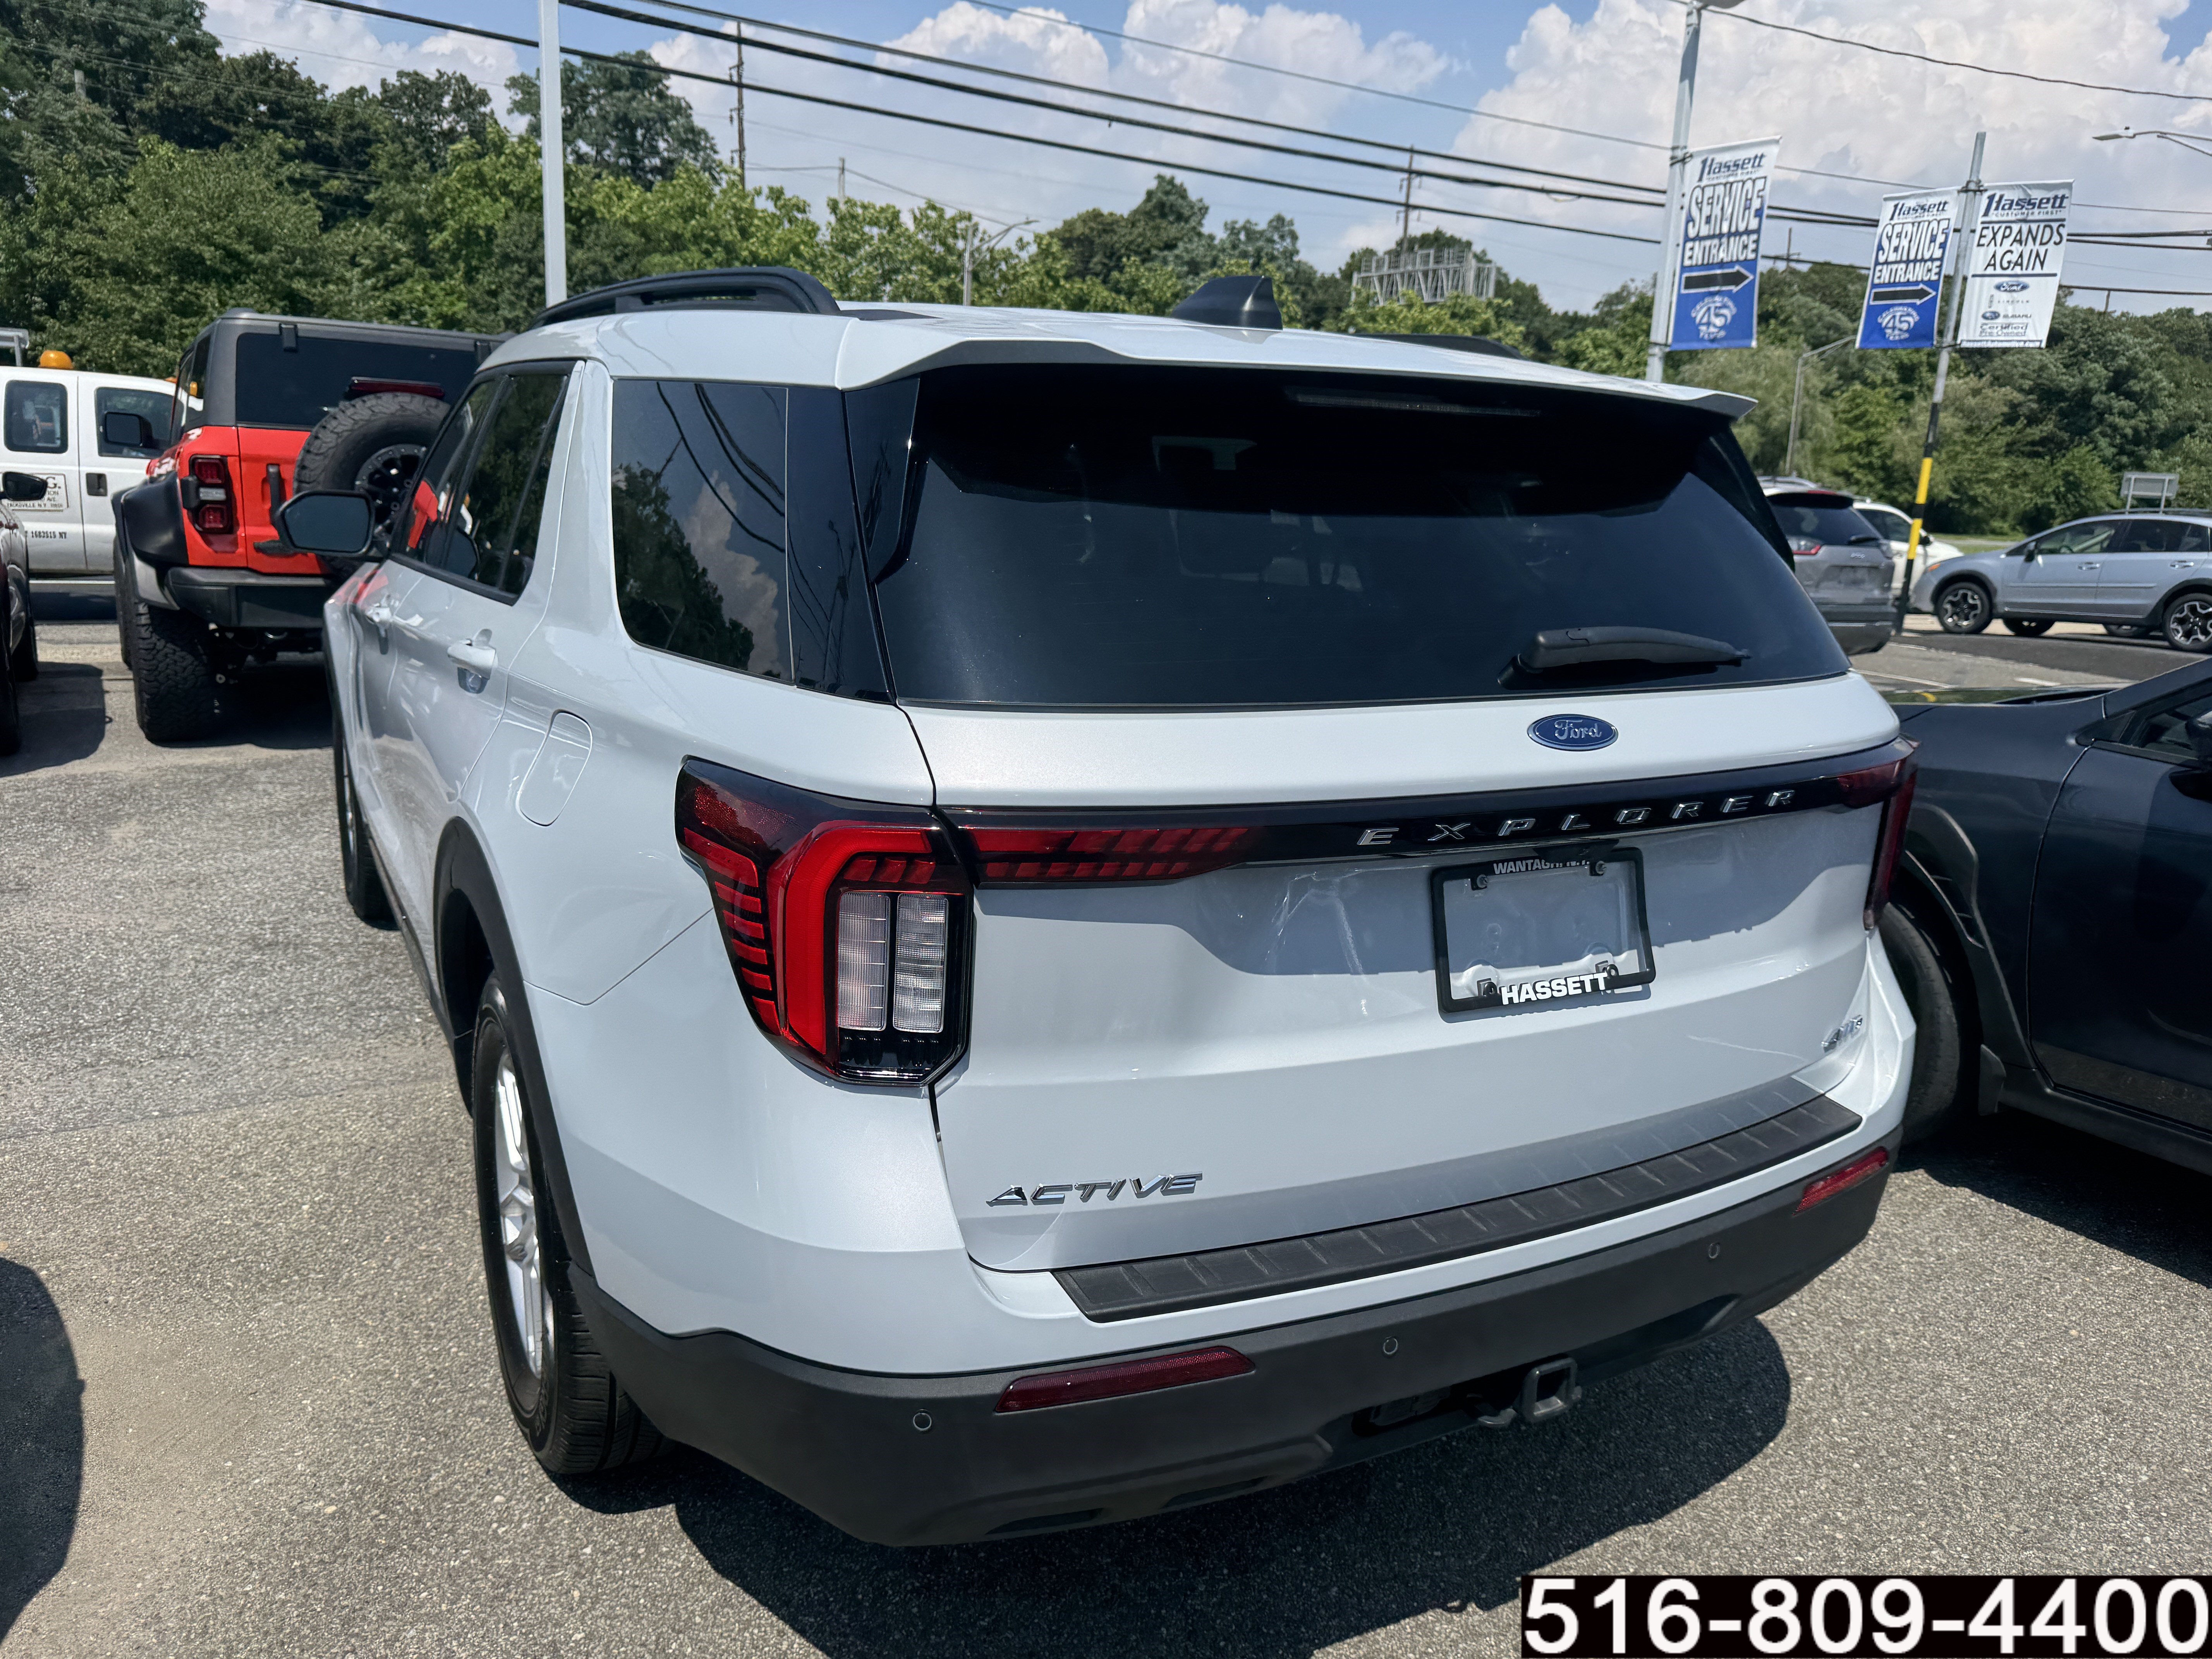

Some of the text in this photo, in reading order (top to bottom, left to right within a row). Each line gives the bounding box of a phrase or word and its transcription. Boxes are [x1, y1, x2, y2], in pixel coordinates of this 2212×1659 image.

[1697, 153, 1766, 182] Hassett
[1687, 176, 1767, 239] SERVICE
[1889, 201, 1949, 221] Hassett
[1981, 192, 2069, 217] Hassett
[1878, 218, 1950, 263] SERVICE
[1977, 223, 2066, 247] EXPANDS
[1683, 233, 1759, 267] ENTRANCE
[1984, 248, 2048, 271] AGAIN
[1873, 260, 1941, 284] ENTRANCE
[1554, 719, 1602, 740] Ford
[1356, 789, 1795, 846] EXPLORER
[1501, 972, 1607, 1005] HASSETT
[986, 1171, 1202, 1207] ACTIVE
